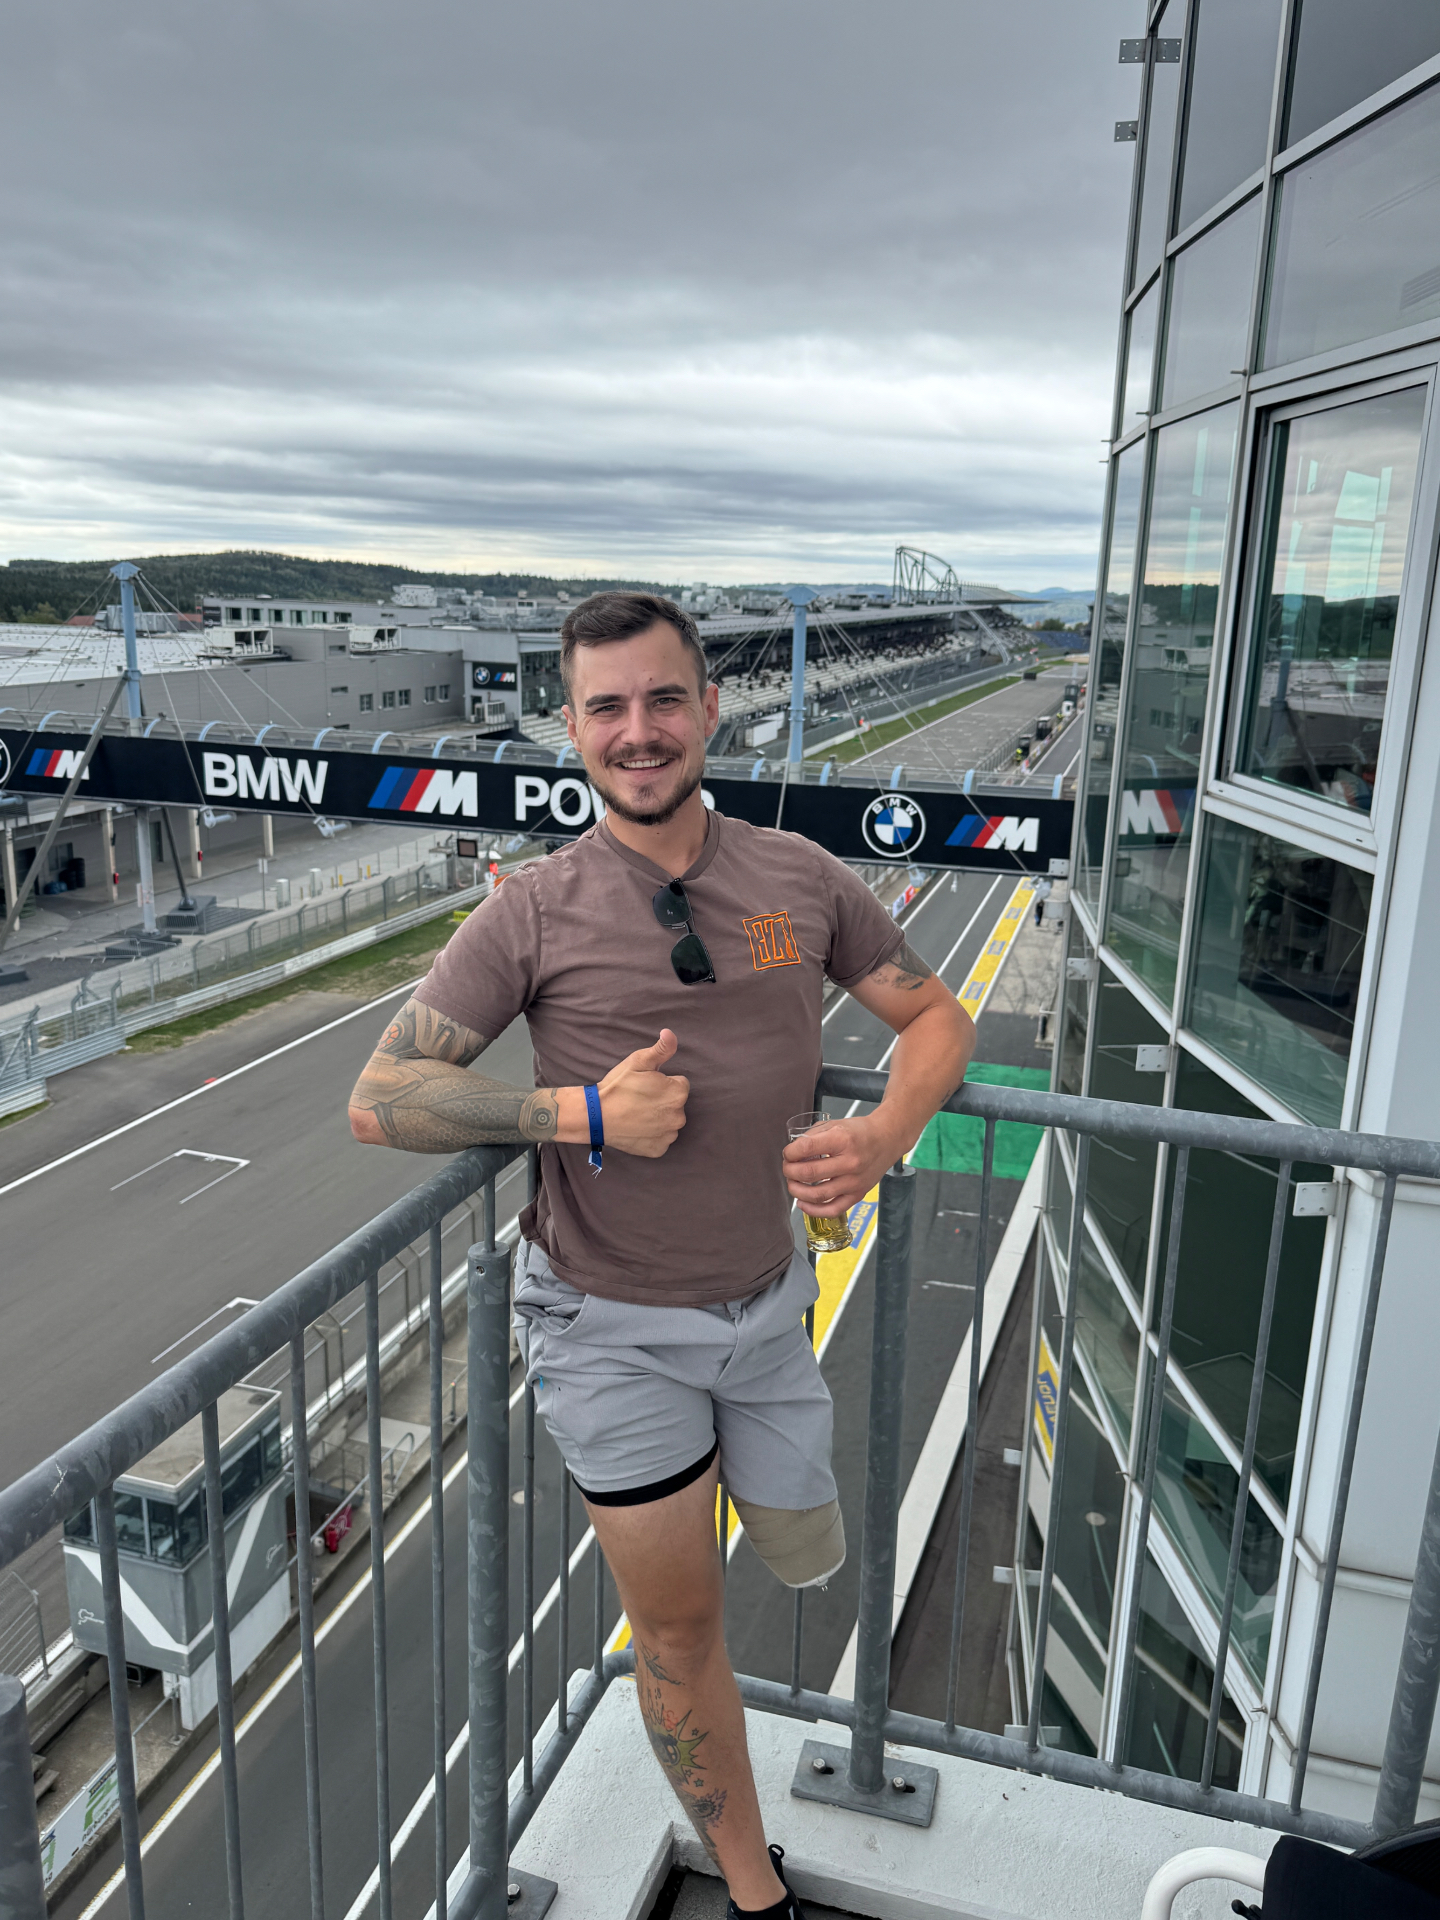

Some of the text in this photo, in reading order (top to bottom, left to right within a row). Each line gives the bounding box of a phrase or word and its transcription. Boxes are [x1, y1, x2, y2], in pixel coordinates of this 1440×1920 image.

[52, 749, 90, 781] M
[202, 751, 329, 805] BMW
[415, 769, 479, 818] M
[871, 797, 918, 817] BMW
[988, 815, 1040, 854] M
